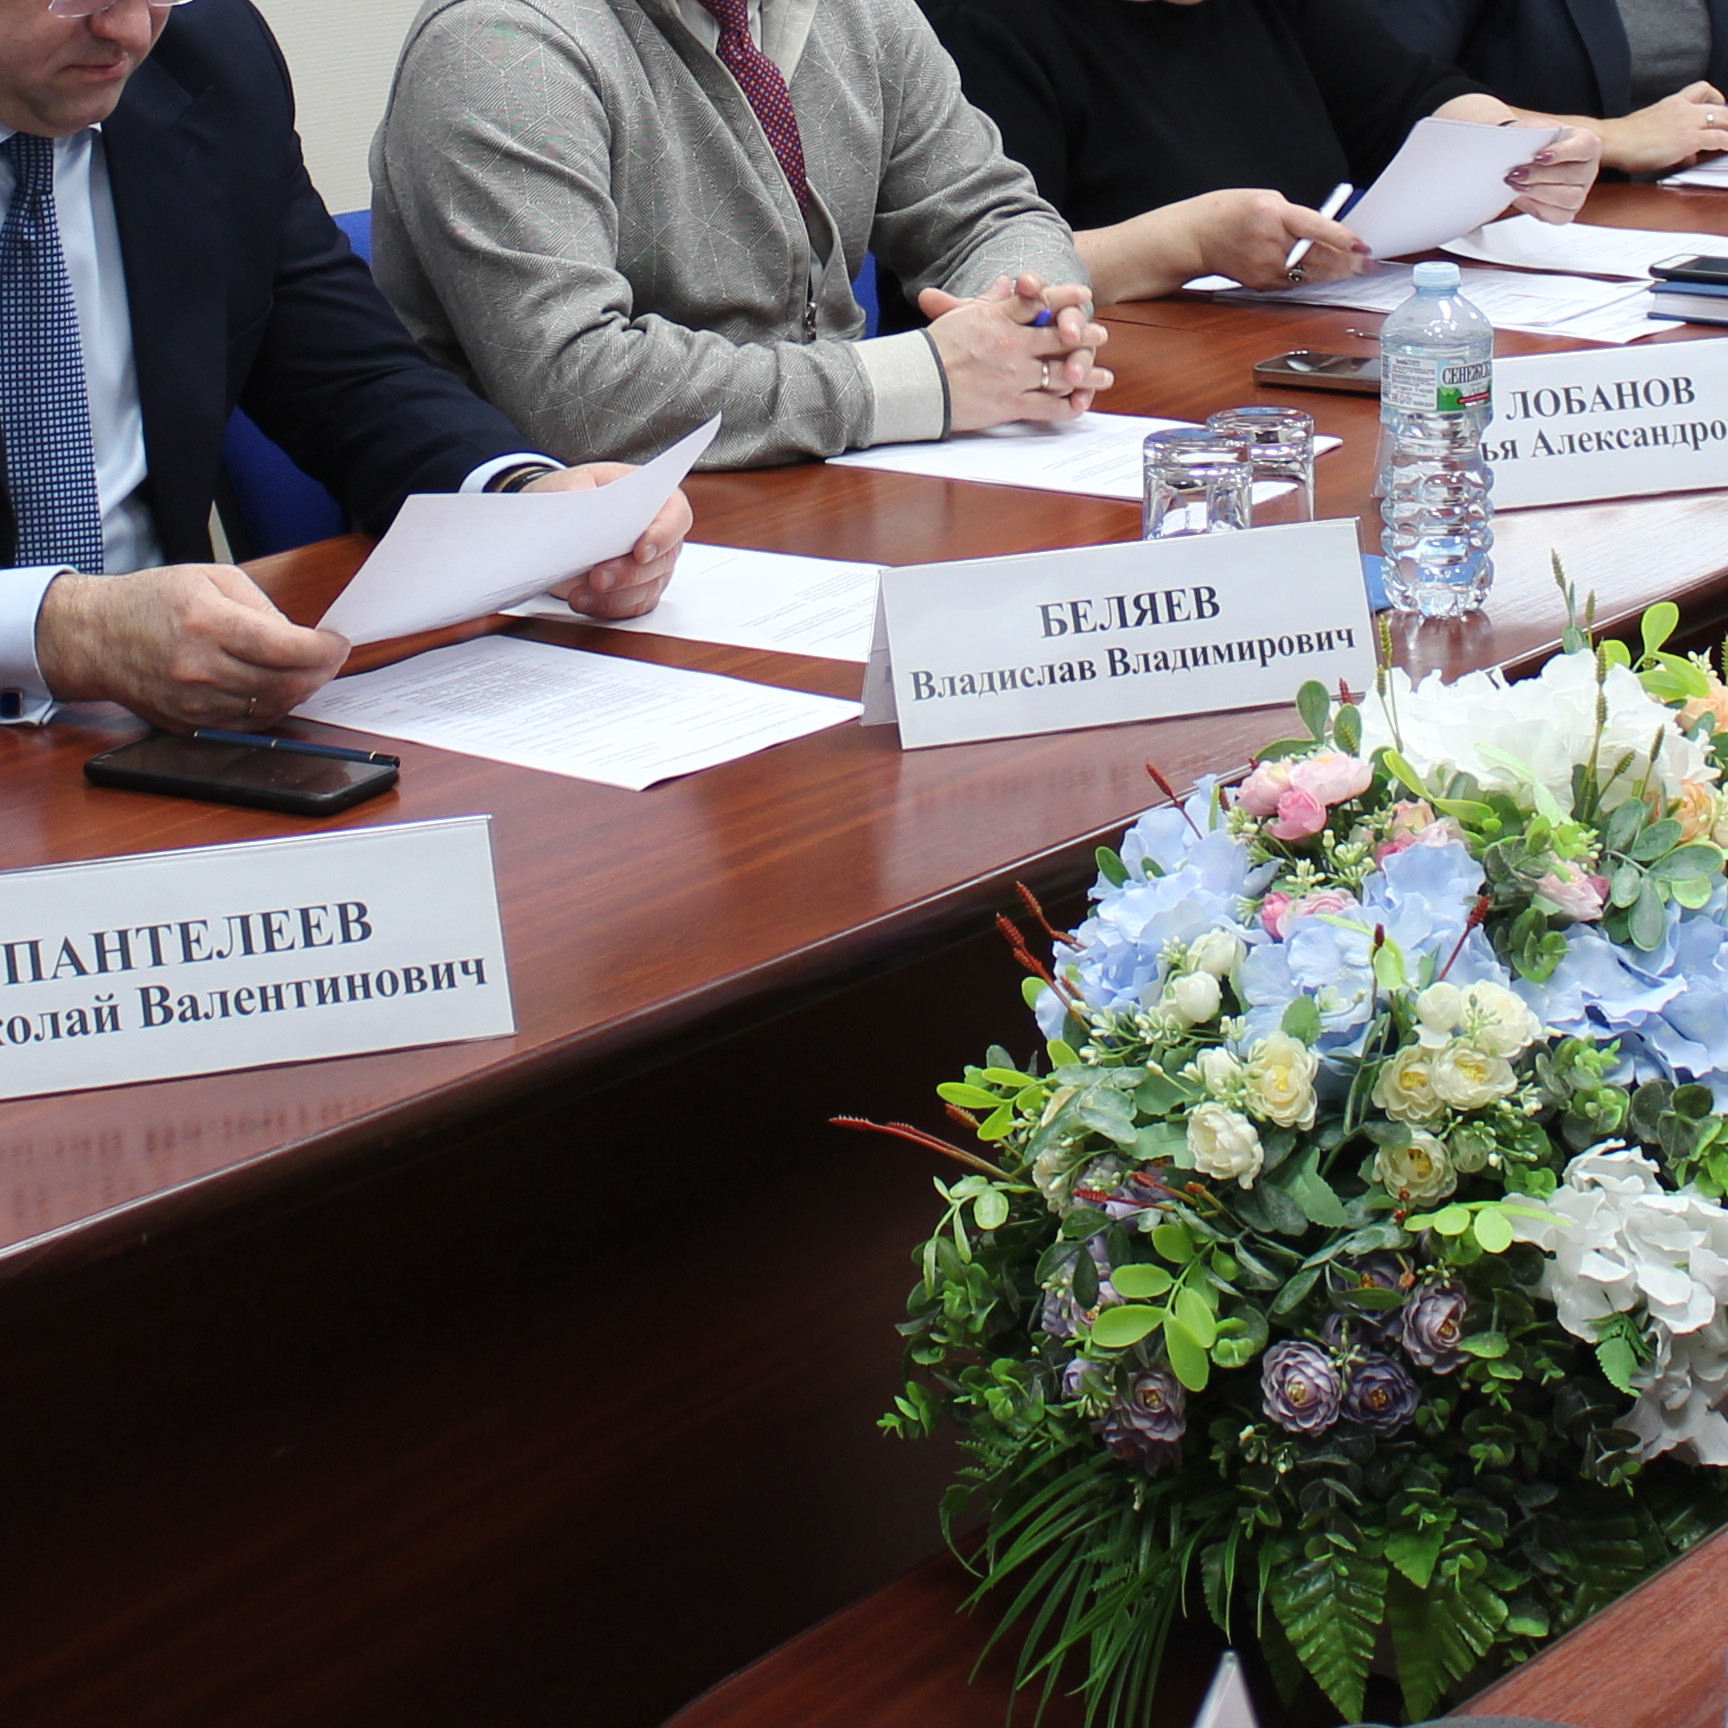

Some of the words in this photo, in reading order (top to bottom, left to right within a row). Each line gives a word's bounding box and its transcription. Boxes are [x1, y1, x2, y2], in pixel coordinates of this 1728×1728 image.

[1505, 375, 1696, 422] ЛОБАНОВ
[1037, 585, 1221, 639] БЕЛЯЕВ
[909, 659, 1097, 702] Владислав
[1104, 625, 1357, 679] Владимирович
[134, 957, 488, 1029] Валентинович
